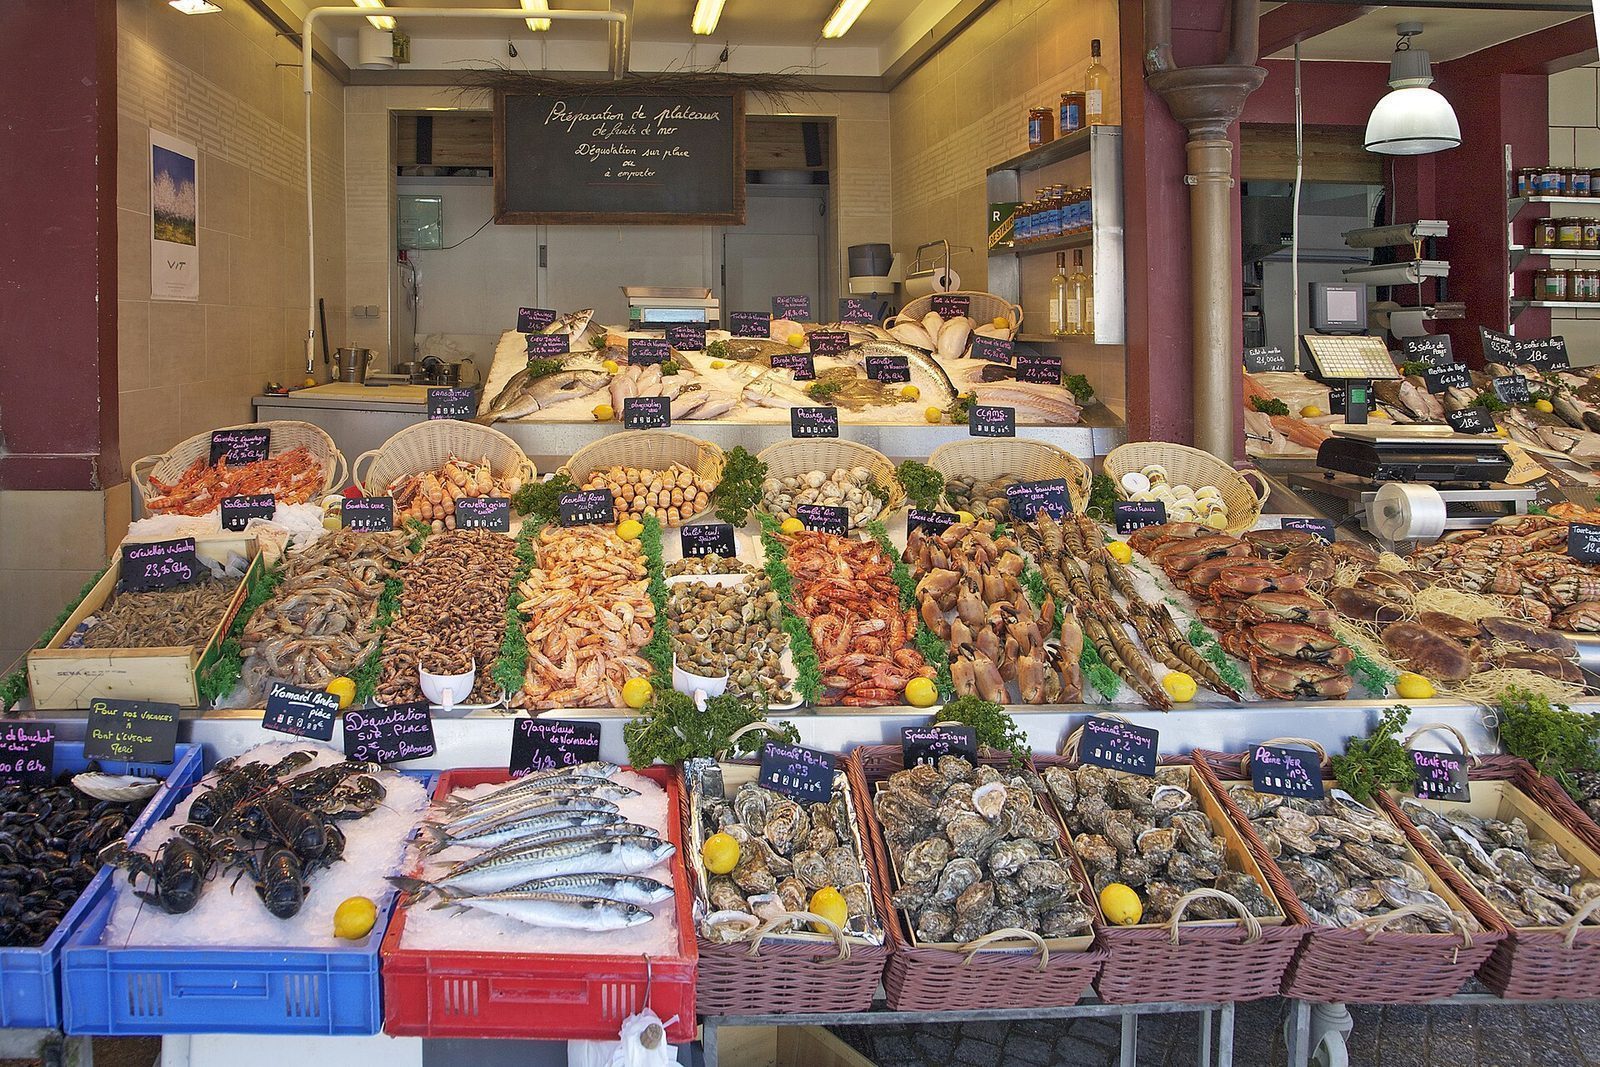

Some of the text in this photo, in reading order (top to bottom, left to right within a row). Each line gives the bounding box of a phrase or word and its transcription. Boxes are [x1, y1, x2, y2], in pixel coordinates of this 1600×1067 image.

[544, 101, 721, 132] Préparation de plateaux
[592, 123, 678, 139] de fruits de mer
[574, 143, 691, 162] Dégustation sur place
[604, 167, 656, 181] à emporter
[993, 210, 1001, 222] R
[1408, 341, 1418, 353] 3
[1514, 342, 1523, 352] 3
[1526, 350, 1550, 363] 18€
[270, 683, 312, 705] Homard
[93, 702, 117, 716] Pour
[122, 710, 138, 719] nos
[308, 707, 332, 720] pièce
[345, 708, 427, 734] Dégustation
[1087, 720, 1122, 738] Spéciale
[92, 729, 114, 740] Pont
[393, 723, 430, 739] PLACE
[903, 728, 940, 744] Spéciale
[550, 735, 560, 745] de
[803, 749, 829, 770] Perle
